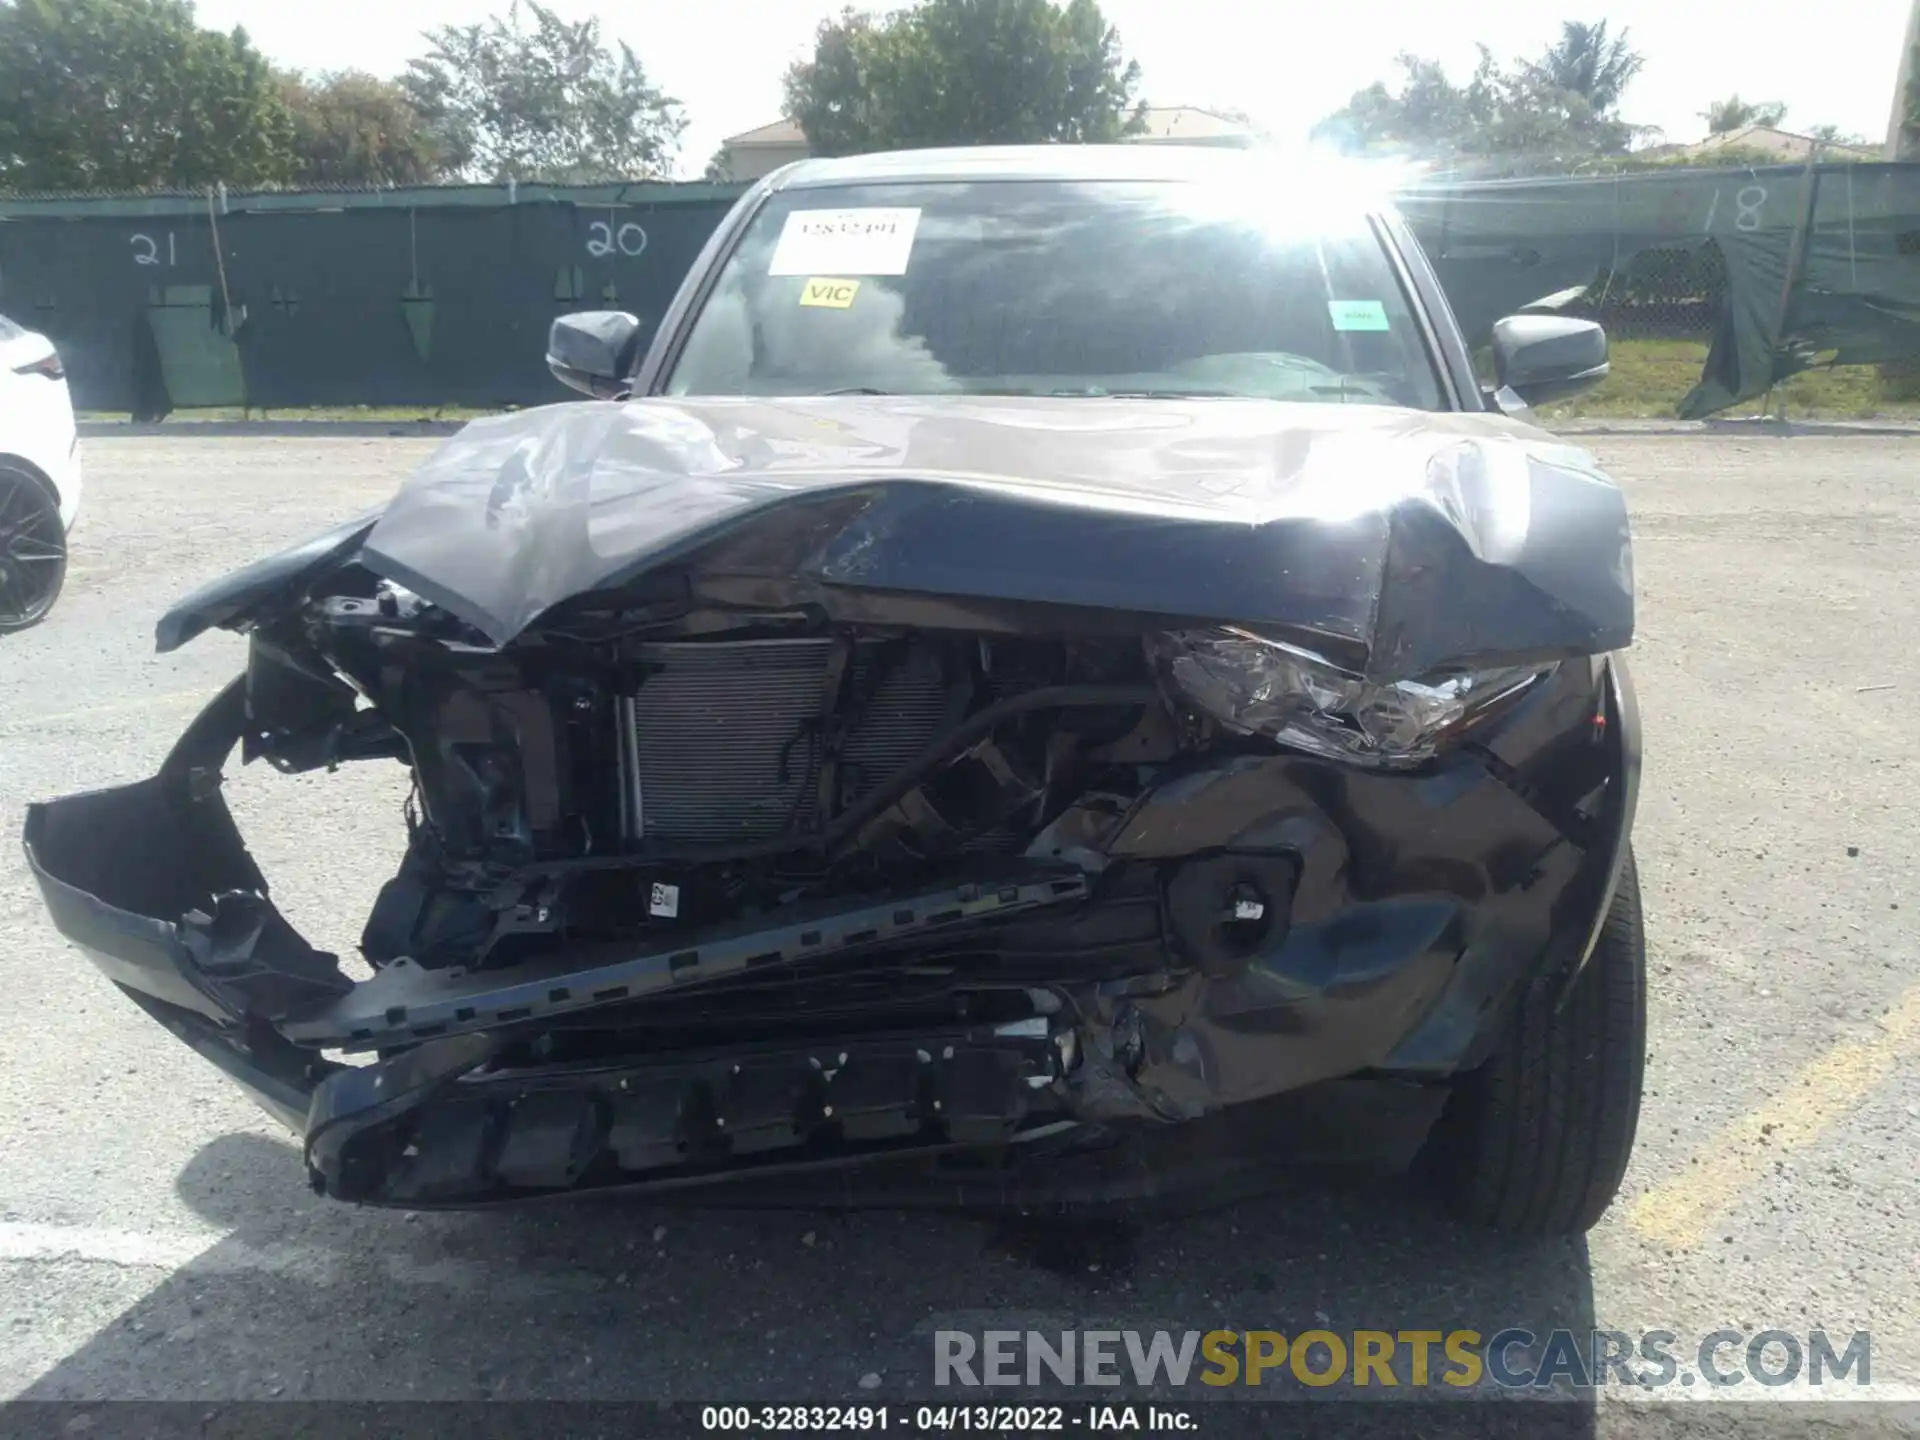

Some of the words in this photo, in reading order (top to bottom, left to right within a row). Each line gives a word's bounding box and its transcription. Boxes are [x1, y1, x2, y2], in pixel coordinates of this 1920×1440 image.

[1704, 185, 1767, 231] 18
[129, 231, 176, 266] 21
[587, 221, 647, 256] 20
[810, 284, 852, 301] VIC
